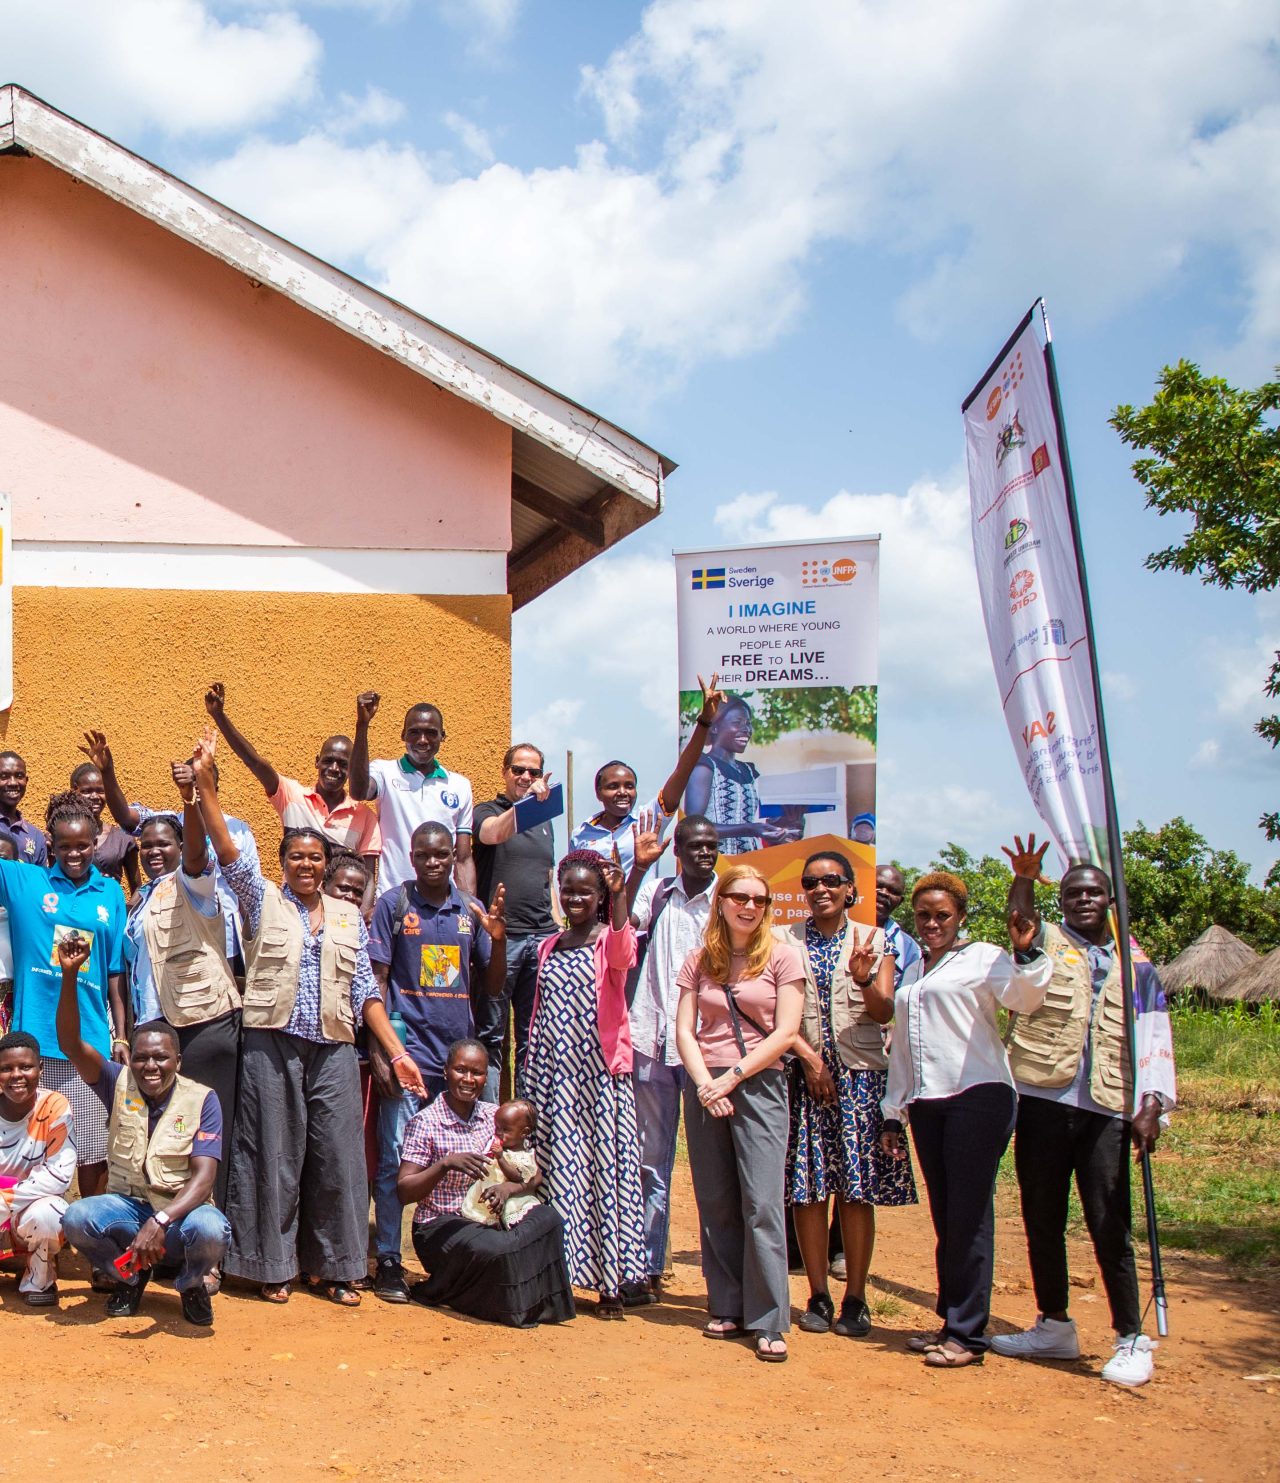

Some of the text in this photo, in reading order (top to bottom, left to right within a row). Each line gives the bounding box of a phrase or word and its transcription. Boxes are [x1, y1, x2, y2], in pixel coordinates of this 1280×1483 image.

[729, 566, 757, 574] Sweden
[728, 575, 775, 589] Sverige
[729, 600, 816, 618] I IMAGINE
[707, 620, 841, 635] A WORLD WHERE YOUNG
[739, 638, 807, 650] PEOPLE ARE
[721, 651, 825, 667] FREE TO LIVE
[745, 668, 829, 682] DREAMS...
[403, 927, 420, 935] care
